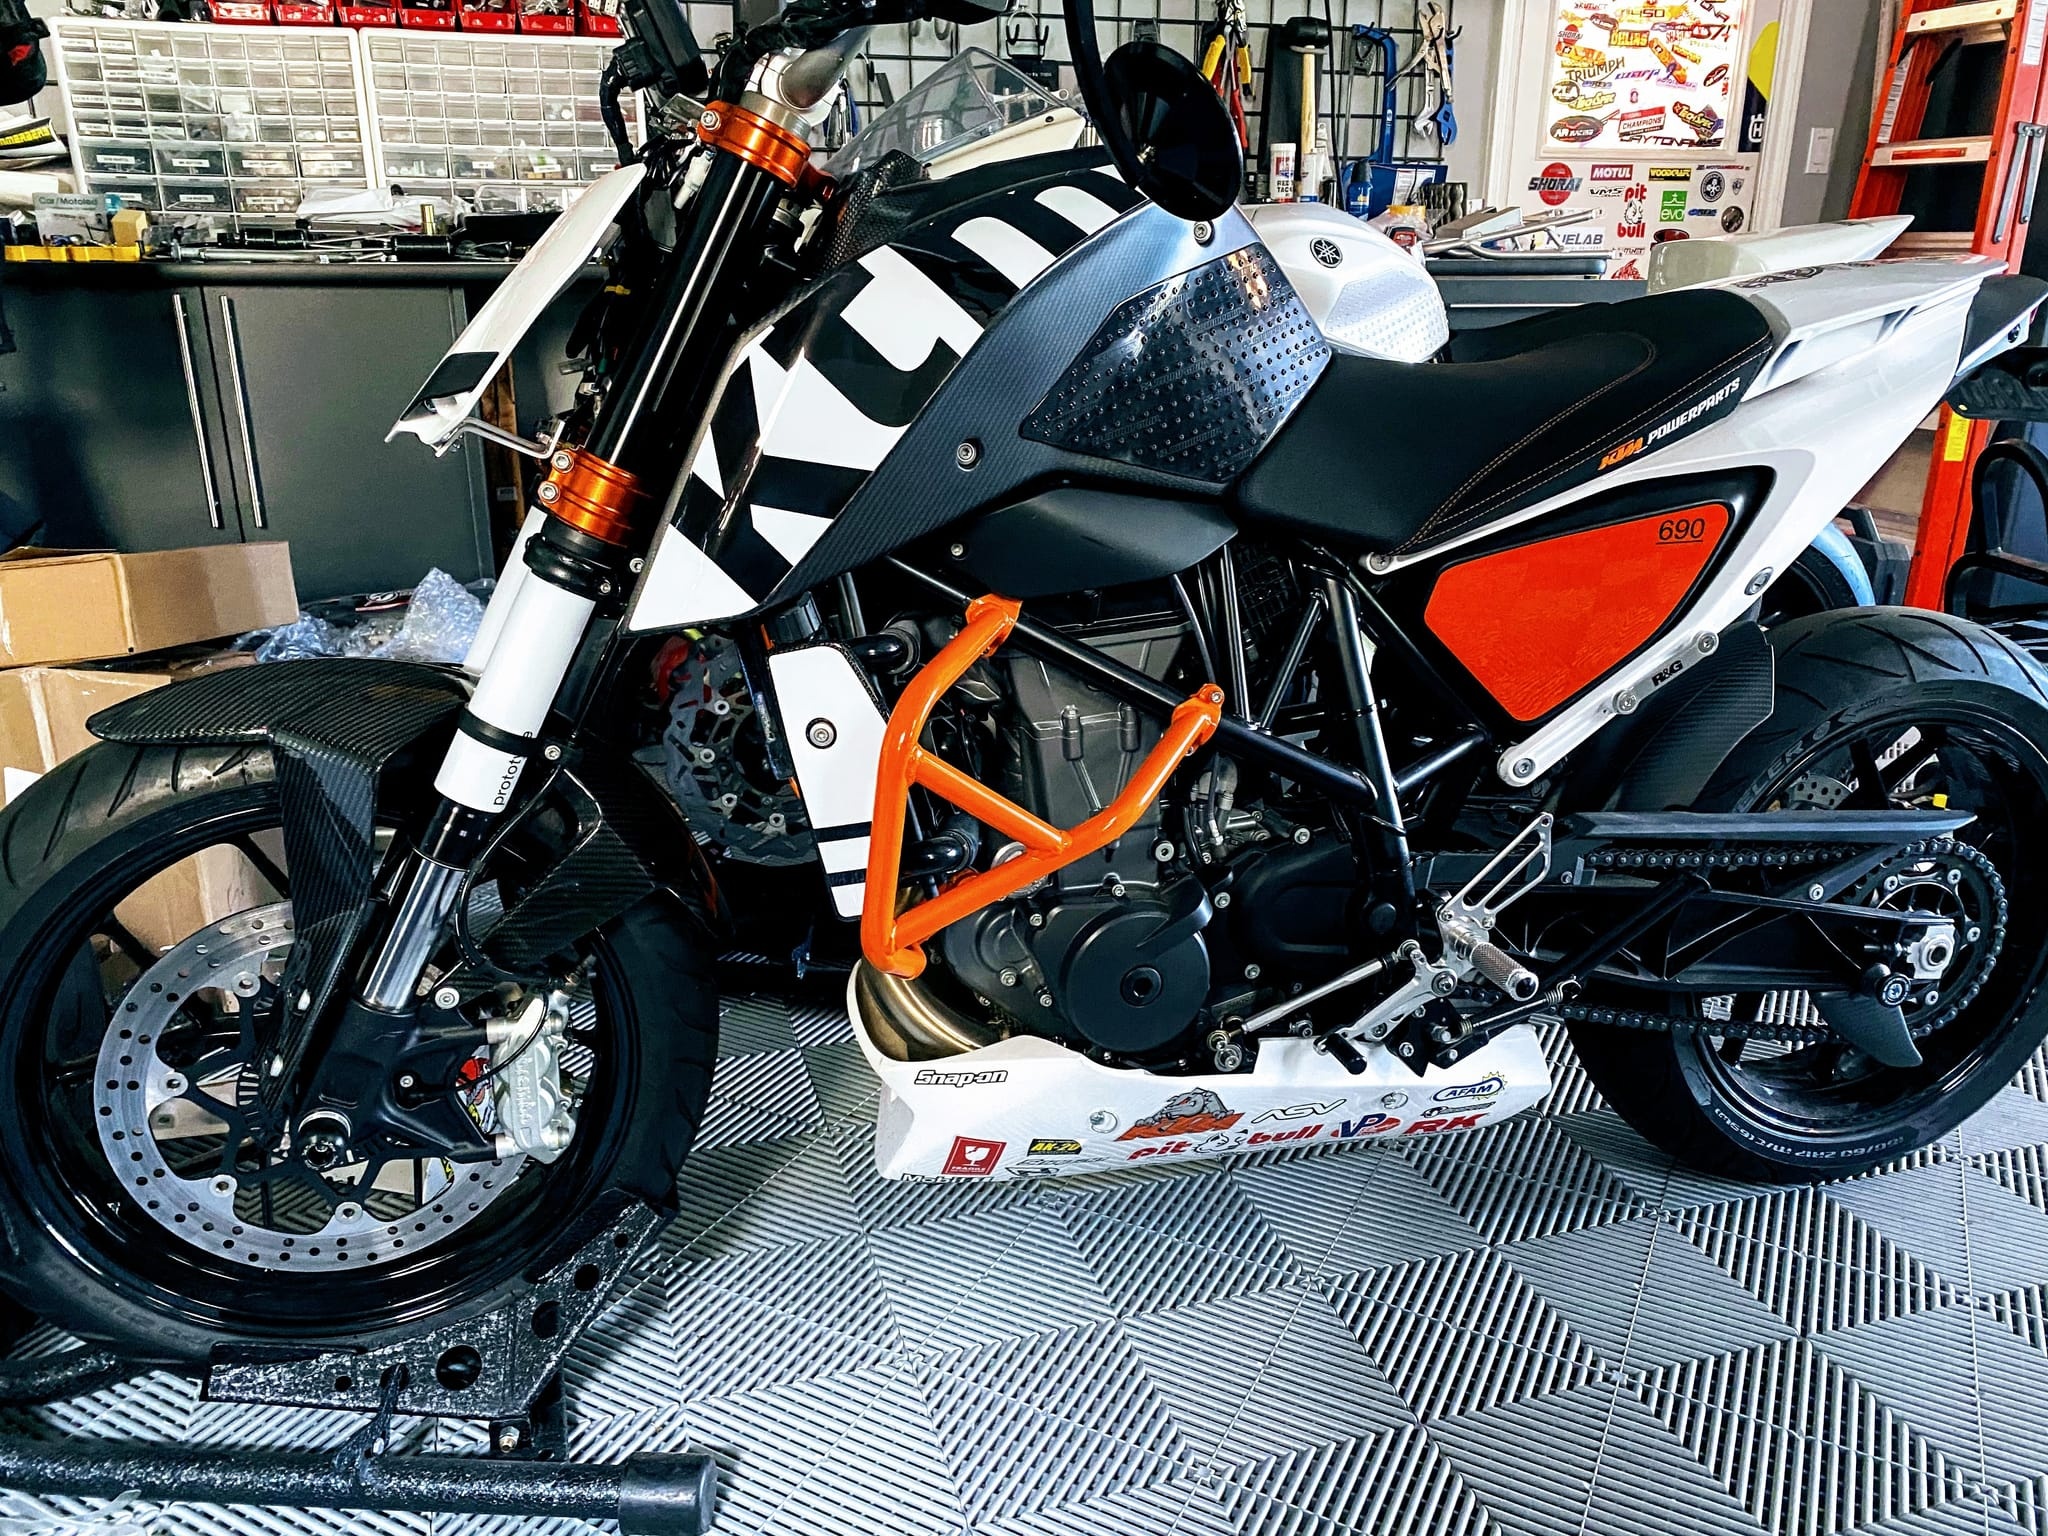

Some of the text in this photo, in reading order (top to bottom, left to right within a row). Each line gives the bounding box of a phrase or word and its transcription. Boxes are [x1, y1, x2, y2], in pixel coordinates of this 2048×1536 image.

[1566, 57, 1625, 82] TRIUMPH
[1623, 117, 1662, 130] CHAMPIONS
[1593, 168, 1630, 178] MOTUL
[1528, 177, 1582, 191] SHORAI
[1624, 183, 1647, 202] pit
[1661, 208, 1684, 220] evo
[1617, 222, 1645, 238] bull
[1598, 377, 1740, 470] KTM POWERPARTS
[1659, 518, 1705, 541] 690
[1652, 660, 1683, 687] R&G
[914, 1069, 1009, 1089] Snap-on
[1445, 1084, 1493, 1097] AFAM
[1251, 1099, 1348, 1124] ASV
[1403, 1112, 1488, 1134] RK
[1127, 1124, 1325, 1160] pit bull
